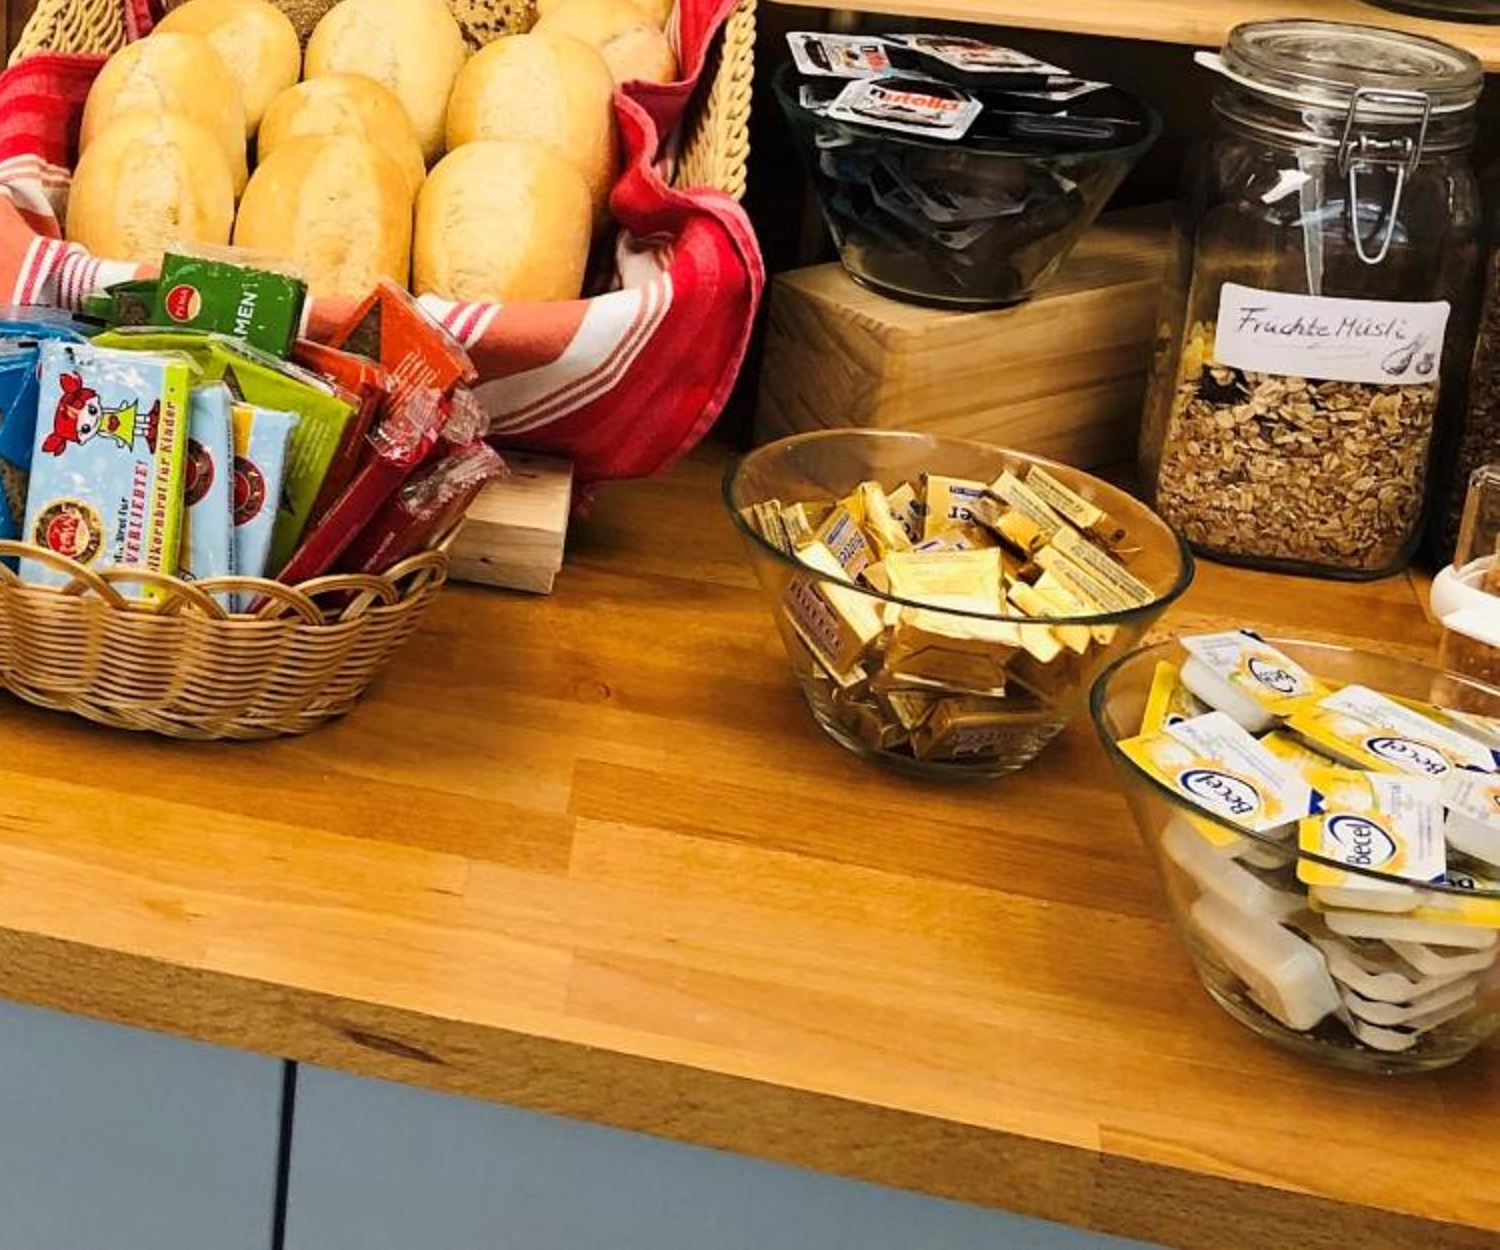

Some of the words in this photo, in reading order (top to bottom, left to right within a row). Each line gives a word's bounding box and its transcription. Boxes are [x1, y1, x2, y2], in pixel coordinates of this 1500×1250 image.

[870, 88, 959, 112] nutella
[1194, 775, 1253, 814] Becel
[1345, 823, 1372, 864] Becel
